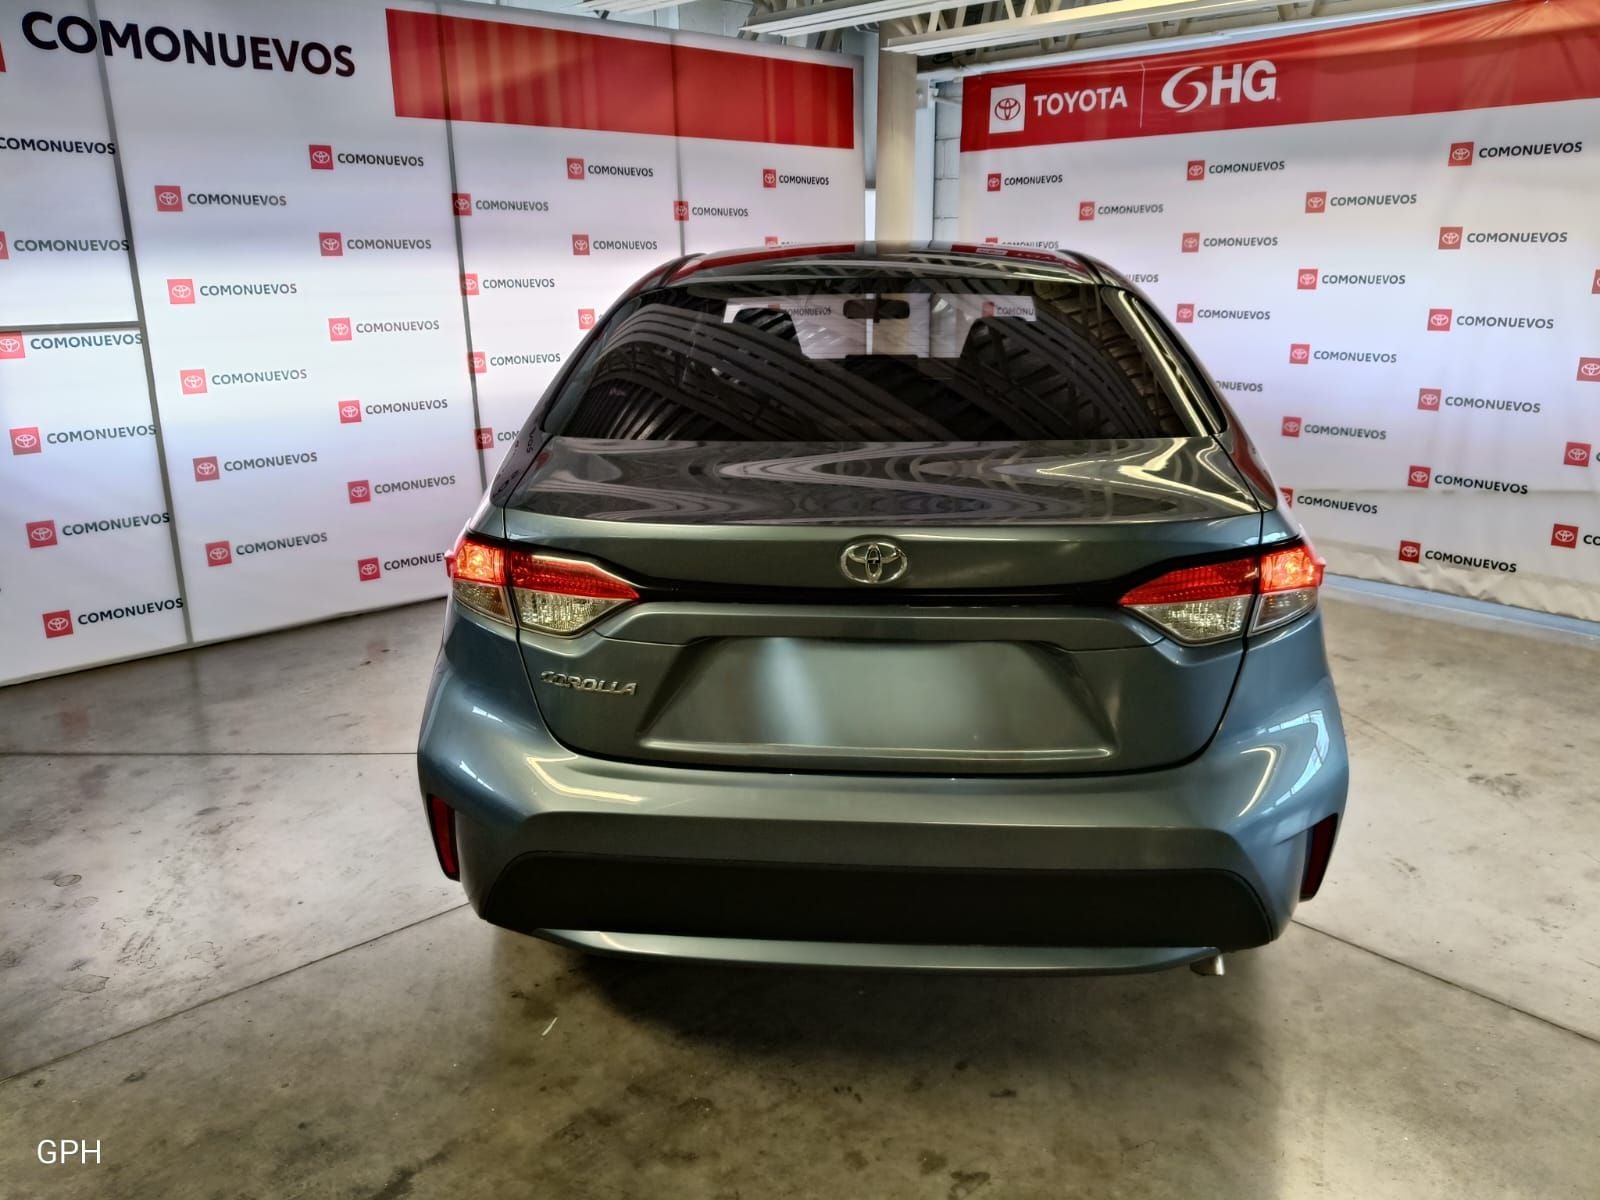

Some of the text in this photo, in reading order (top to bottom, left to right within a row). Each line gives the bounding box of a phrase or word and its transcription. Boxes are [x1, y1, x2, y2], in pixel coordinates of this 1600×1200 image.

[21, 11, 355, 77] COMONUEVOS
[1034, 59, 1278, 118] TOYOTA HG
[1479, 141, 1583, 160] COMONUEVOS
[338, 153, 424, 167] COMONUEVOS
[1208, 160, 1285, 174] COMONUEVOS
[588, 164, 653, 177] COMONUEVOS
[779, 174, 829, 185] COMONUEVOS
[1004, 174, 1064, 186] COMONUEVOS
[188, 193, 286, 207] COMONUEVOS
[475, 199, 548, 212] COMONUEVOS
[1330, 194, 1417, 207] COMONUEVOS
[692, 206, 748, 217] COMONUEVOS
[1097, 203, 1164, 216] COMONUEVOS
[347, 238, 431, 250] COMONUEVOS
[593, 239, 657, 251] COMONUEVOS
[1204, 236, 1278, 248] COMONUEVOS
[1466, 232, 1568, 244] COMONUEVOS
[14, 239, 129, 252] COMONUEVOS
[482, 277, 555, 290] COMONUEVOS
[1322, 274, 1406, 286] COMONUEVOS
[200, 283, 297, 297] COMONUEVOS
[1198, 309, 1270, 320] COMONUEVOS
[356, 320, 439, 333] COMONUEVOS
[1456, 315, 1554, 329] COMONUEVOS
[31, 333, 143, 350] COMONUEVOS
[490, 353, 560, 366] COMONUEVOS
[1313, 350, 1397, 363] COMONUEVOS
[212, 369, 307, 386] COMONUEVOS
[365, 399, 448, 415] COMONUEVOS
[1445, 396, 1541, 413] COMONUEVOS
[47, 424, 156, 445] COMONUEVOS
[1304, 424, 1387, 440] COMONUEVOS
[224, 452, 318, 472] COMONUEVOS
[374, 475, 456, 495] COMONUEVOS
[1434, 473, 1528, 494] COMONUEVOS
[1297, 494, 1378, 515] COMONUEVOS
[62, 512, 170, 536] COMONUEVOS
[236, 532, 327, 556] COMONUEVOS
[384, 552, 446, 571] COMONUE
[1425, 549, 1516, 572] COMONUEVOS
[78, 597, 183, 626] COMONUEVOS
[541, 671, 637, 696] COROLLA
